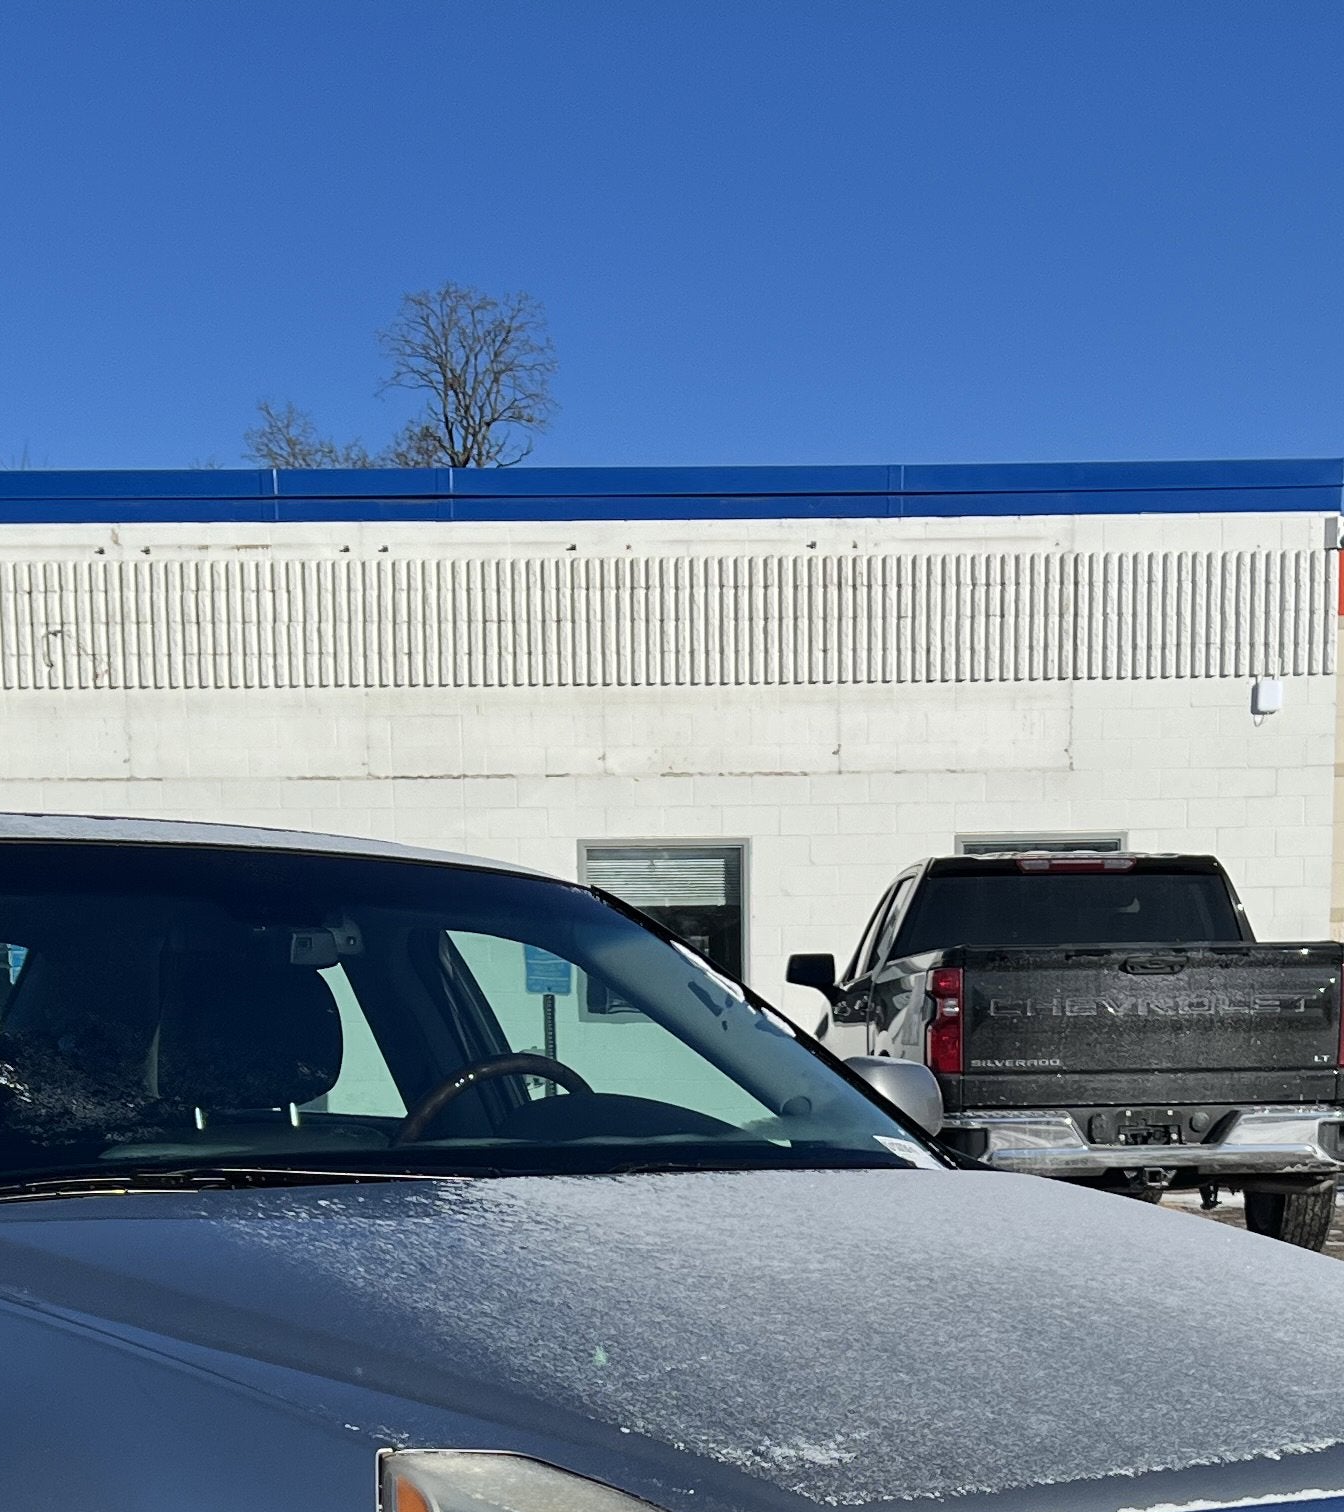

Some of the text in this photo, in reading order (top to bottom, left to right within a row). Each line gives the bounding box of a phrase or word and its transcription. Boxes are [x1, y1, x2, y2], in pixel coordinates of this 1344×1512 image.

[989, 994, 1318, 1016] CHEVROLET
[1313, 1054, 1331, 1062] LT
[970, 1059, 1060, 1067] SILVERADO
